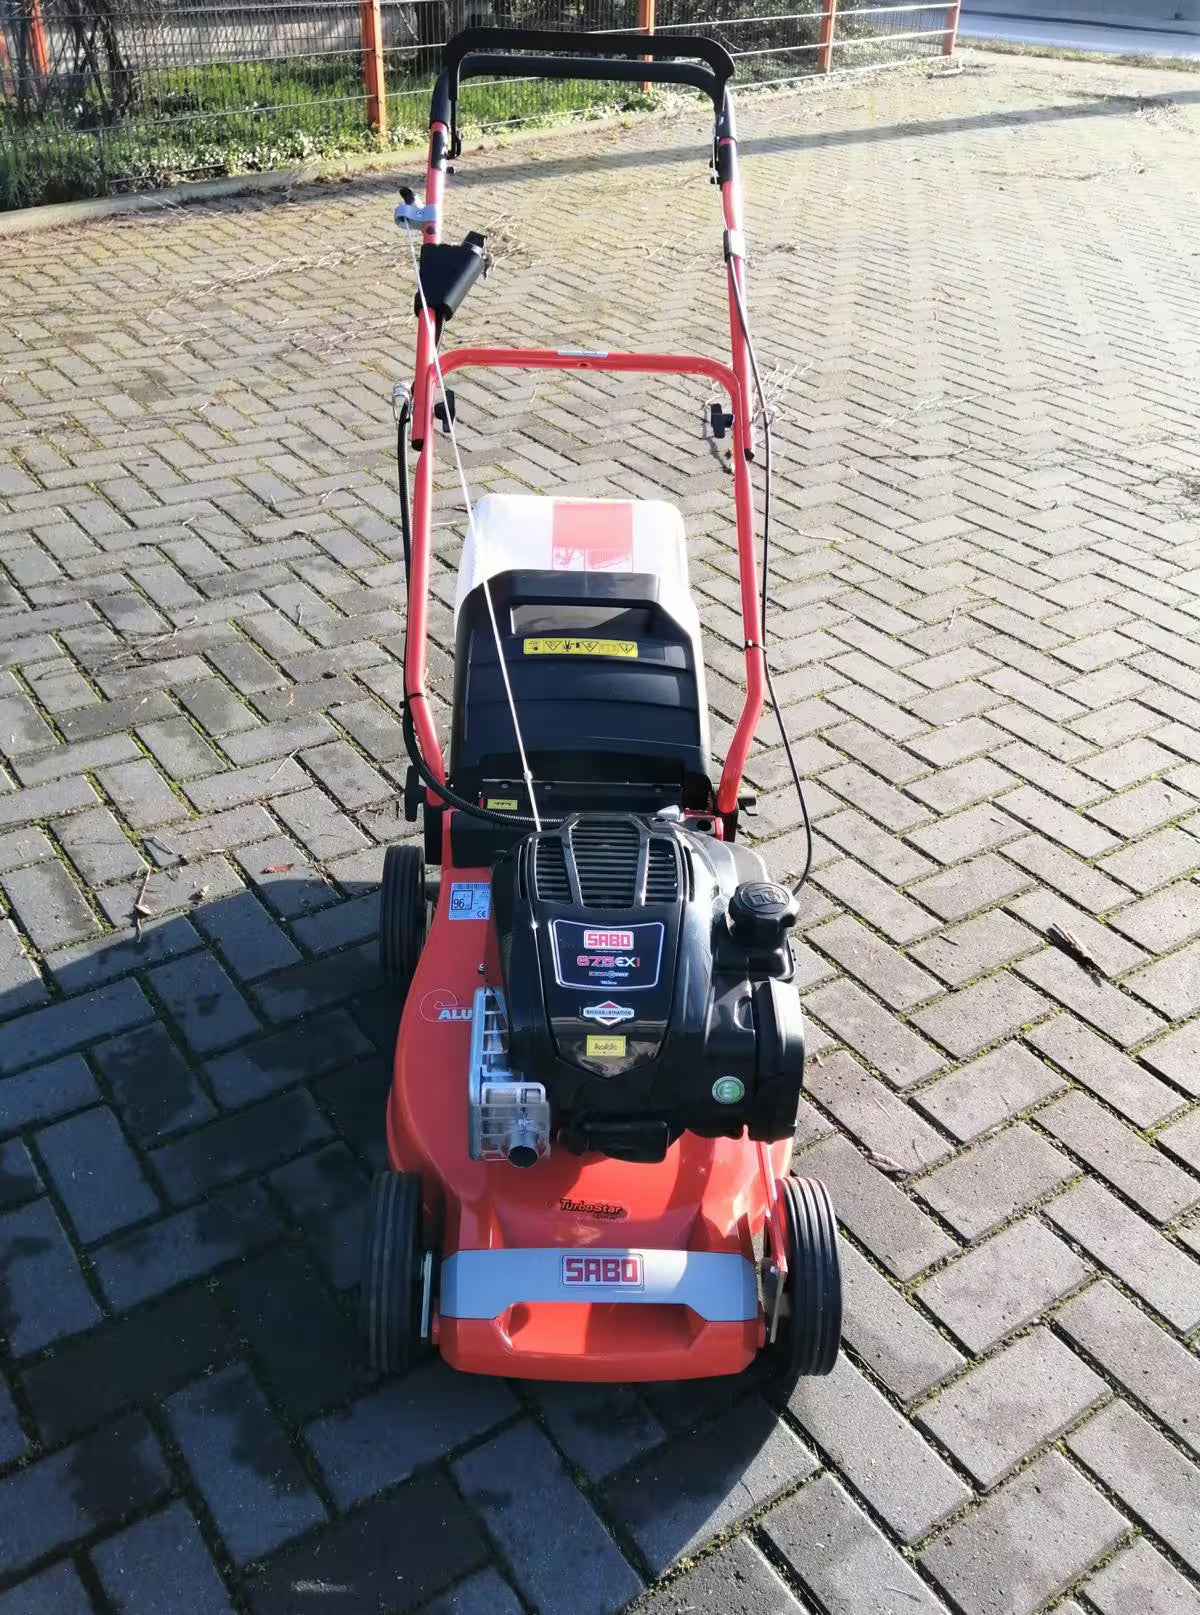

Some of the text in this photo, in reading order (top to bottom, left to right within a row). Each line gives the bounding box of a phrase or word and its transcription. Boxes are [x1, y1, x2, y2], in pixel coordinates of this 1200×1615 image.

[587, 933, 631, 947] SABO
[438, 1008, 472, 1020] ALU
[560, 1199, 622, 1214] TurboStar
[566, 1259, 638, 1282] SABO
